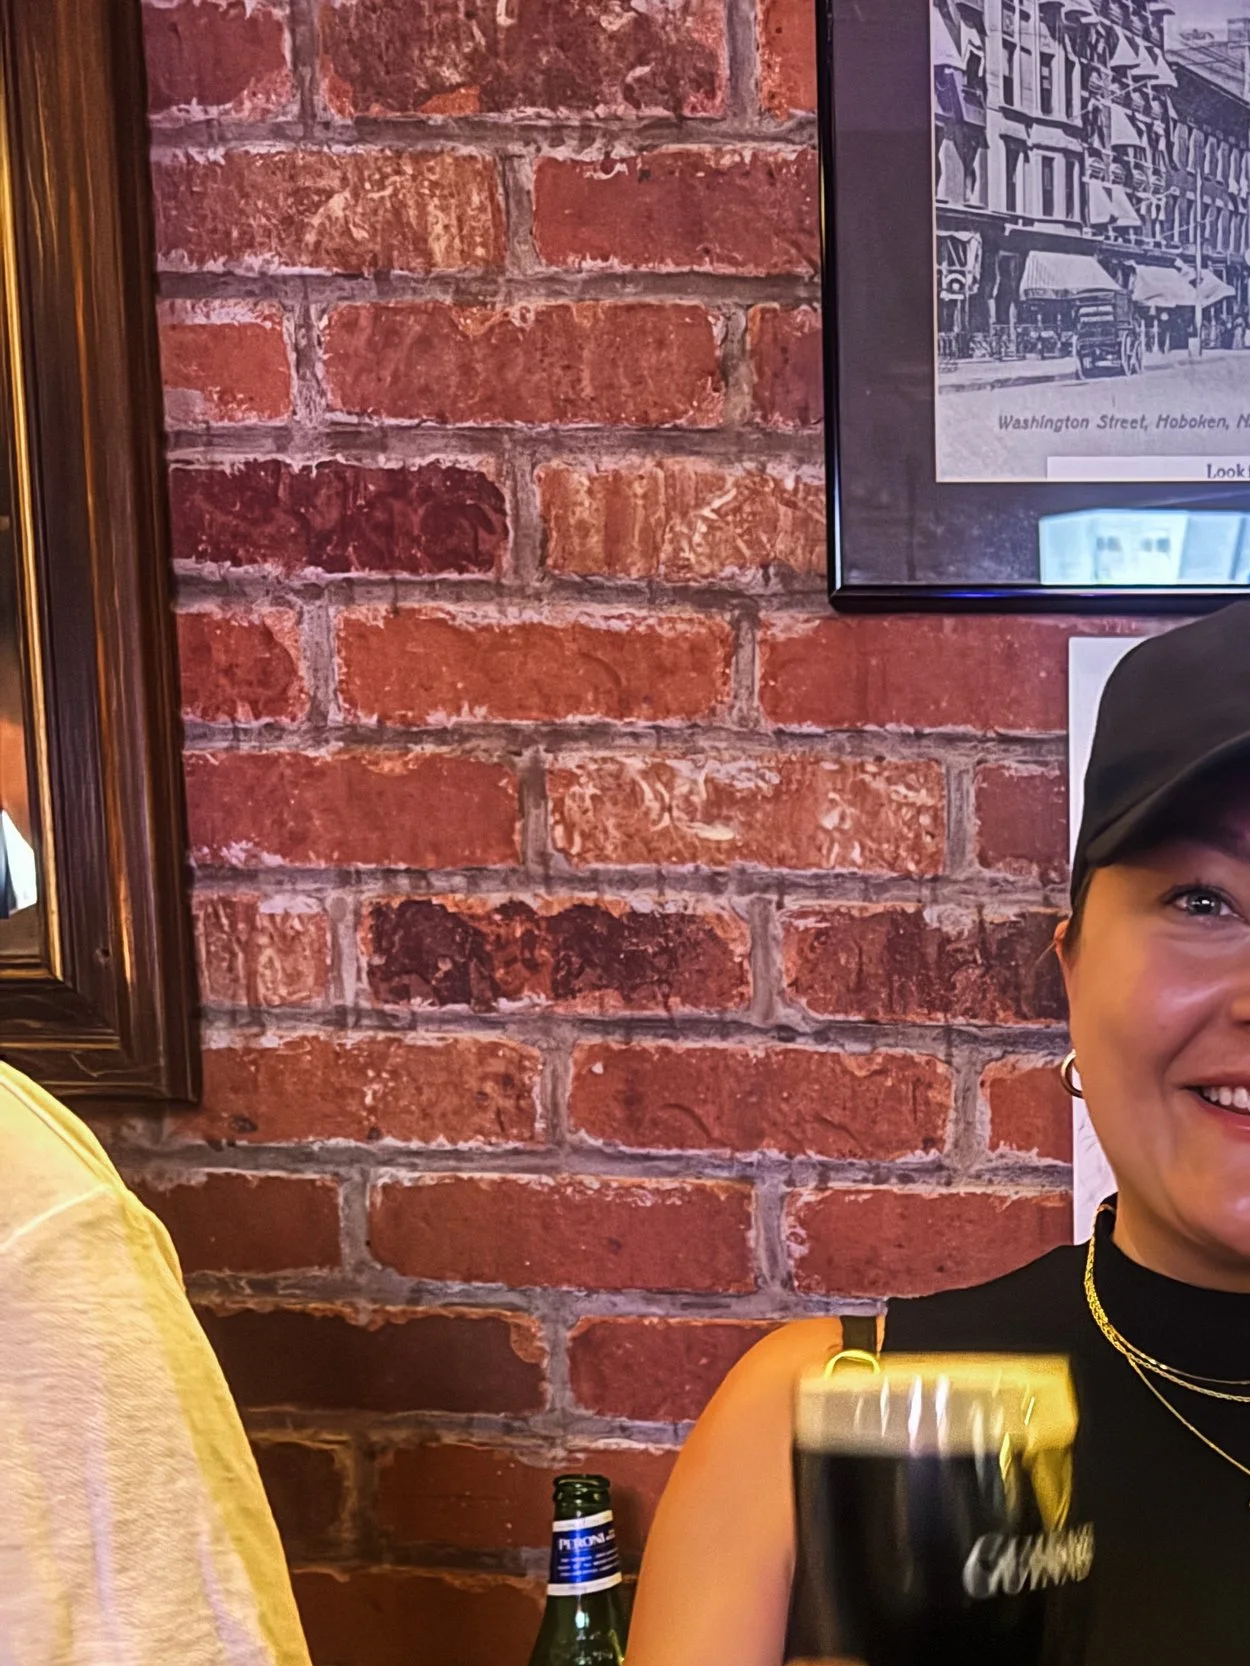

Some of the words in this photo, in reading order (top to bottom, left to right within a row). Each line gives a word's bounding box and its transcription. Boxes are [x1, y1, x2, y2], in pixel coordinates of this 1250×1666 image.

[998, 414, 1089, 433] Washington
[1096, 414, 1149, 431] Street,
[1155, 413, 1230, 431] Hoboken,
[558, 1532, 606, 1551] PERONI
